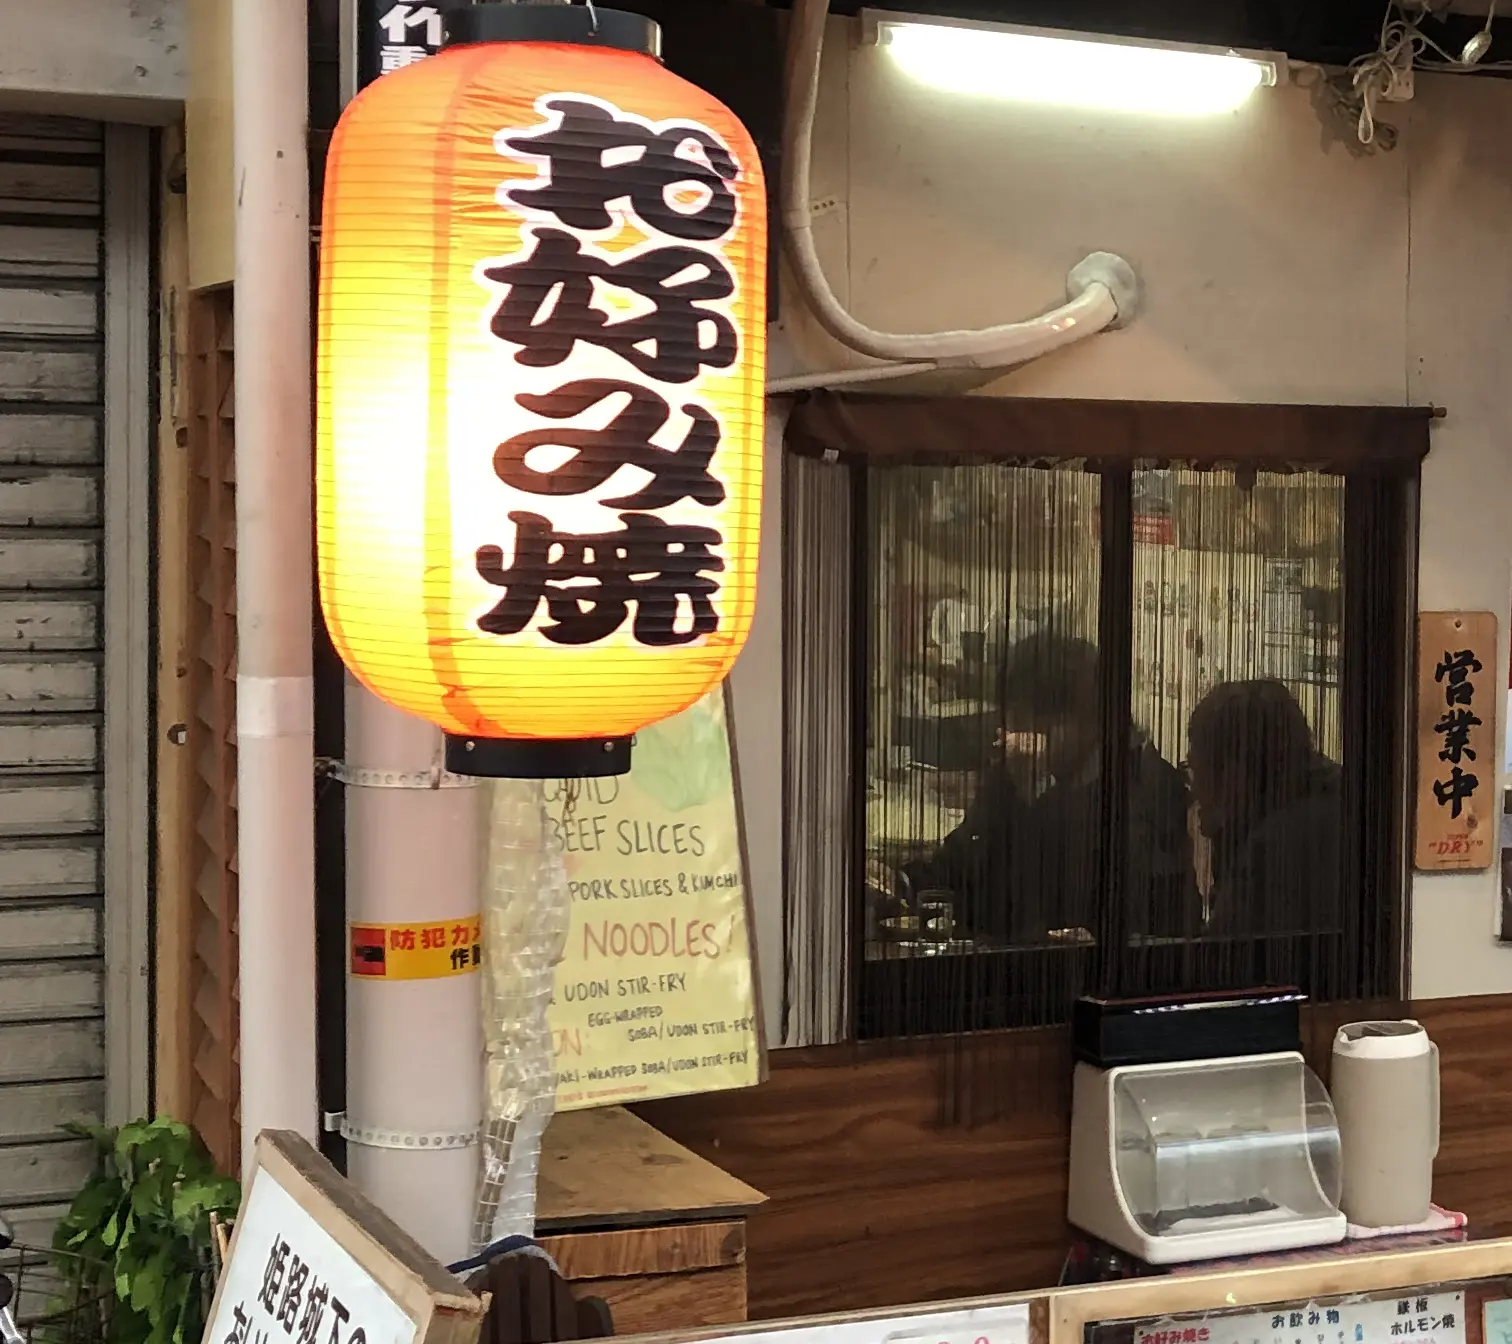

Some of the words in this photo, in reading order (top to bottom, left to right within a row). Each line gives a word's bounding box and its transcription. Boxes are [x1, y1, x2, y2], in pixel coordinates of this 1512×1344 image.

[474, 97, 740, 647] お好み焼
[1433, 649, 1482, 820] 営業中
[548, 815, 607, 852] BEEF
[616, 818, 706, 856] SLICES
[567, 878, 618, 902] PORK
[619, 877, 673, 899] SLICES
[677, 871, 690, 895] &
[691, 872, 739, 894] KIMCHI
[564, 978, 610, 1003] UDON
[616, 972, 687, 997] STIR-FRY
[1272, 1309, 1340, 1328] お飲み物
[1390, 1313, 1456, 1336] ホルモン焼
